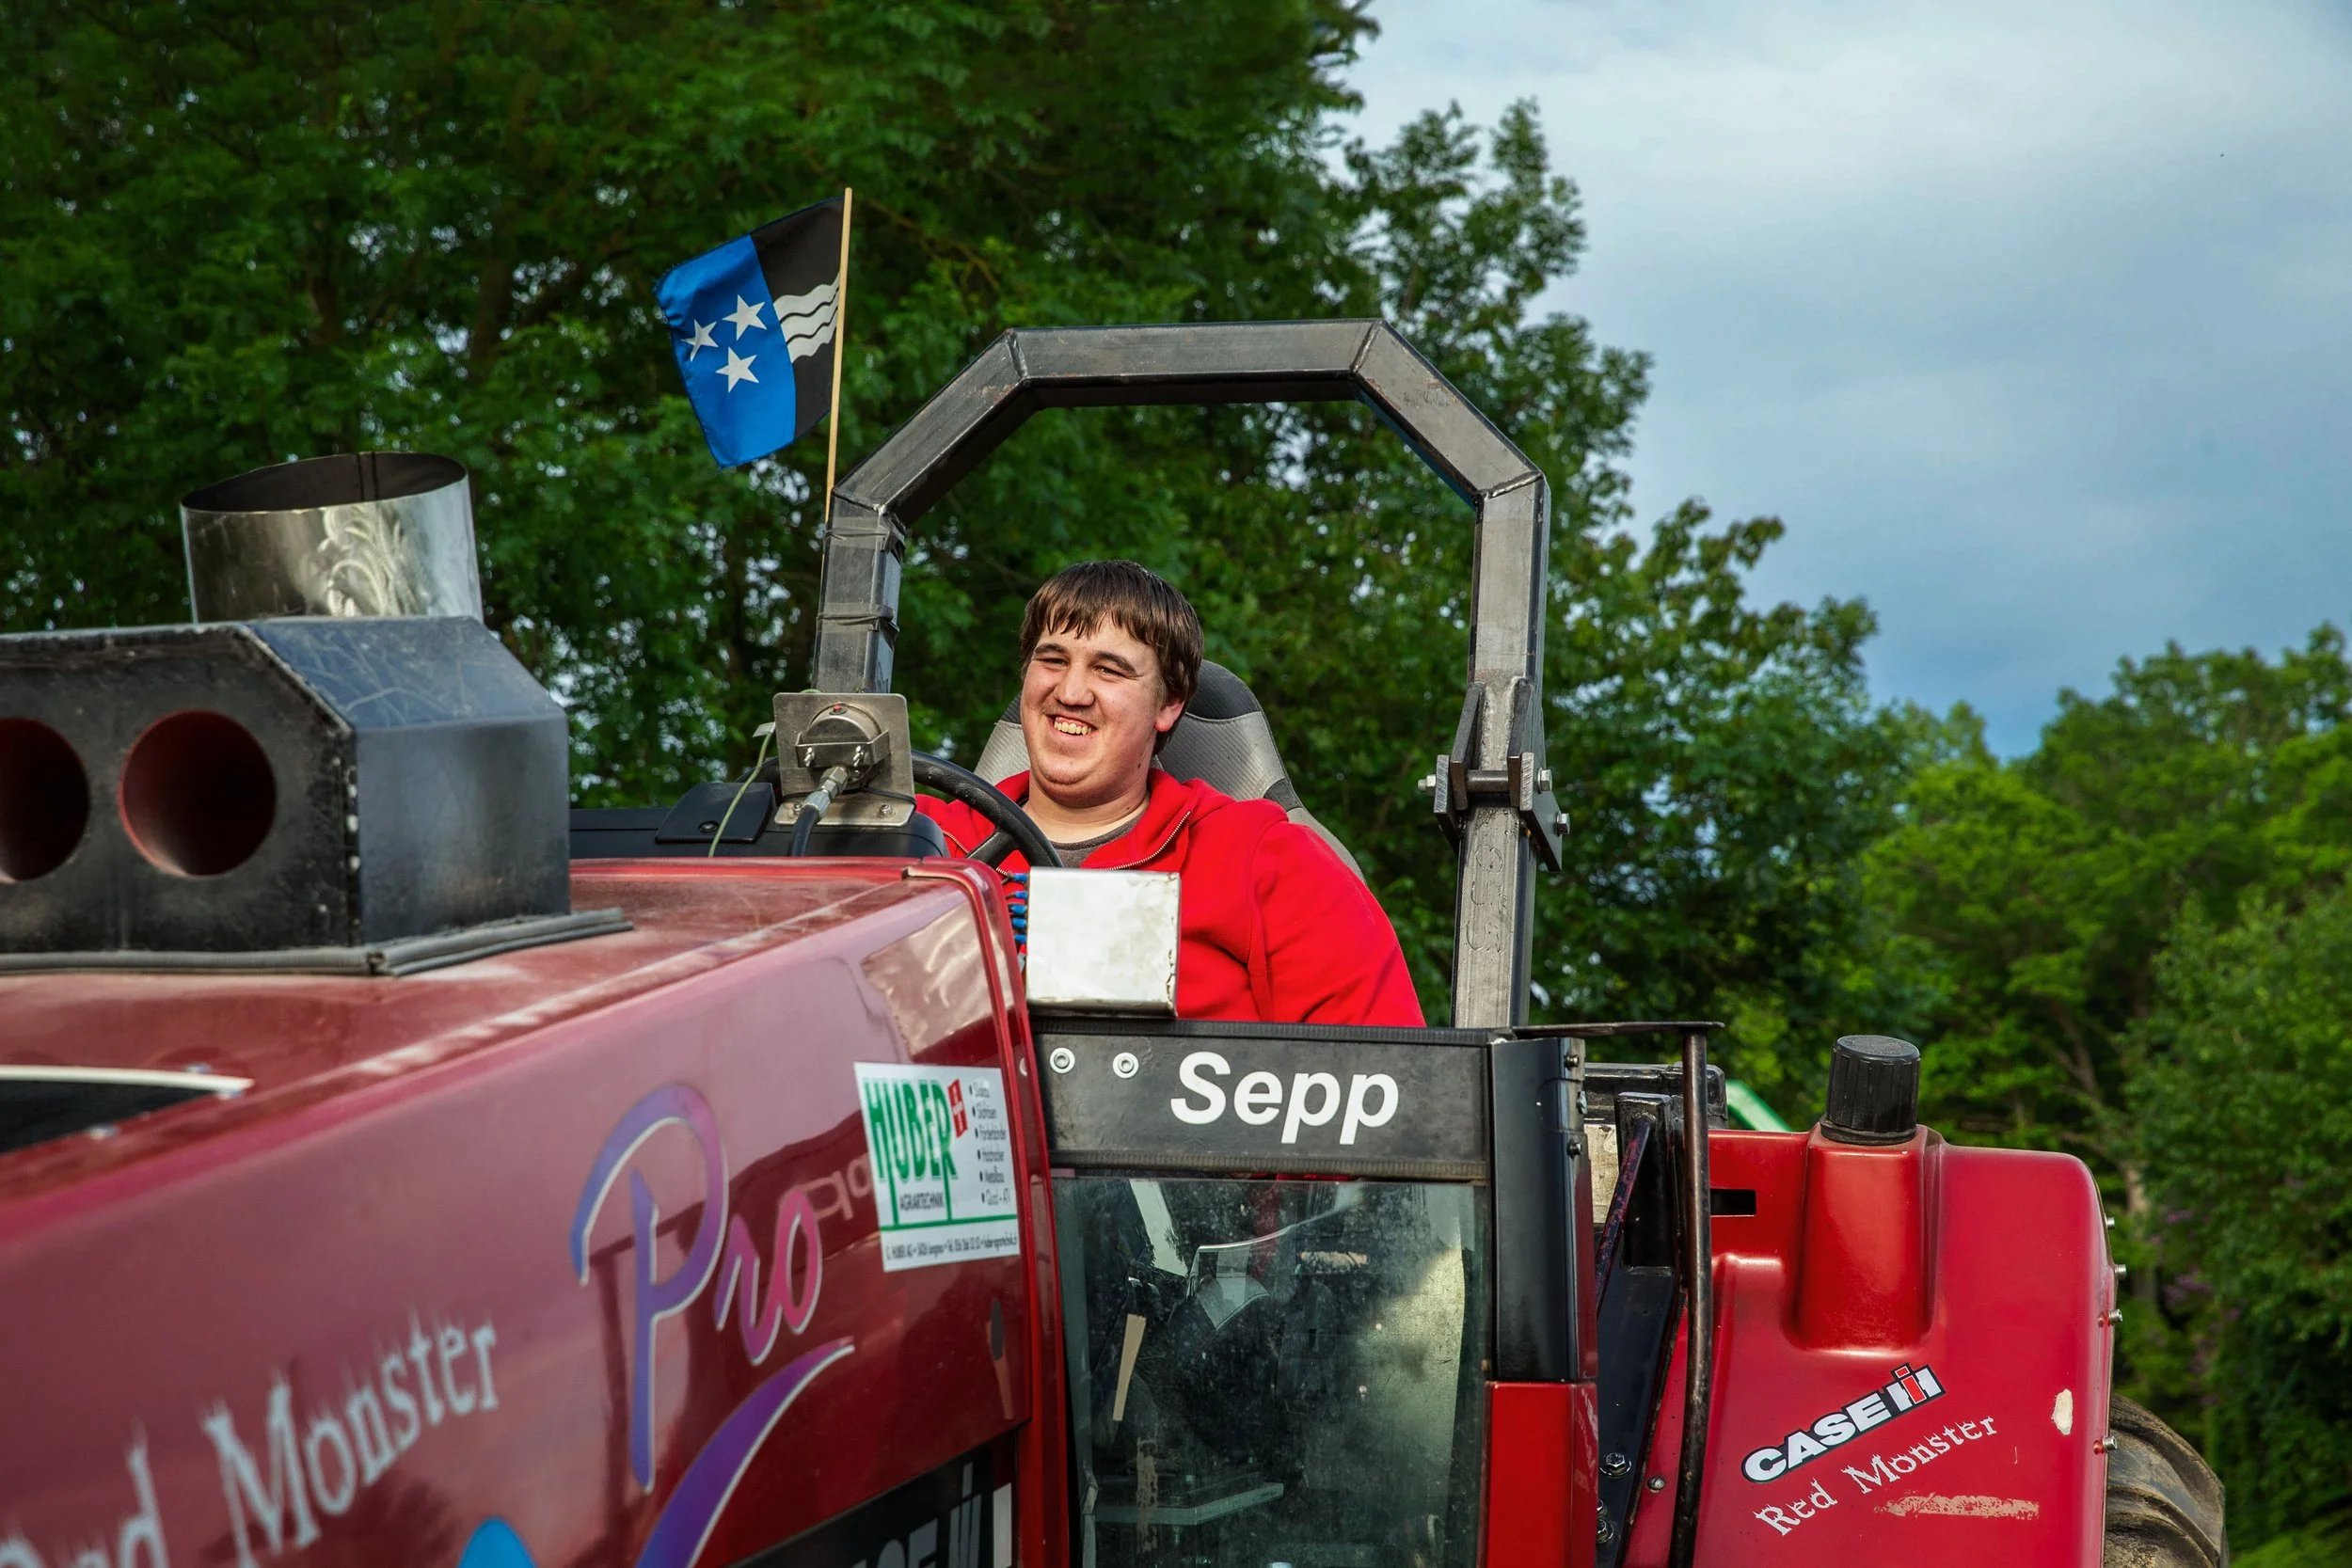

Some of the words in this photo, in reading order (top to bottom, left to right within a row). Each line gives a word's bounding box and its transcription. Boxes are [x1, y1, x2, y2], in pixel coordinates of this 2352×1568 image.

[863, 1079, 959, 1183] HUBER
[1170, 1051, 1399, 1146] Sepp
[569, 1083, 823, 1494] Pro
[204, 1315, 499, 1568] Monster
[1743, 1392, 1893, 1481] CASE
[1752, 1477, 1838, 1536] Red
[1840, 1415, 1997, 1495] Monster
